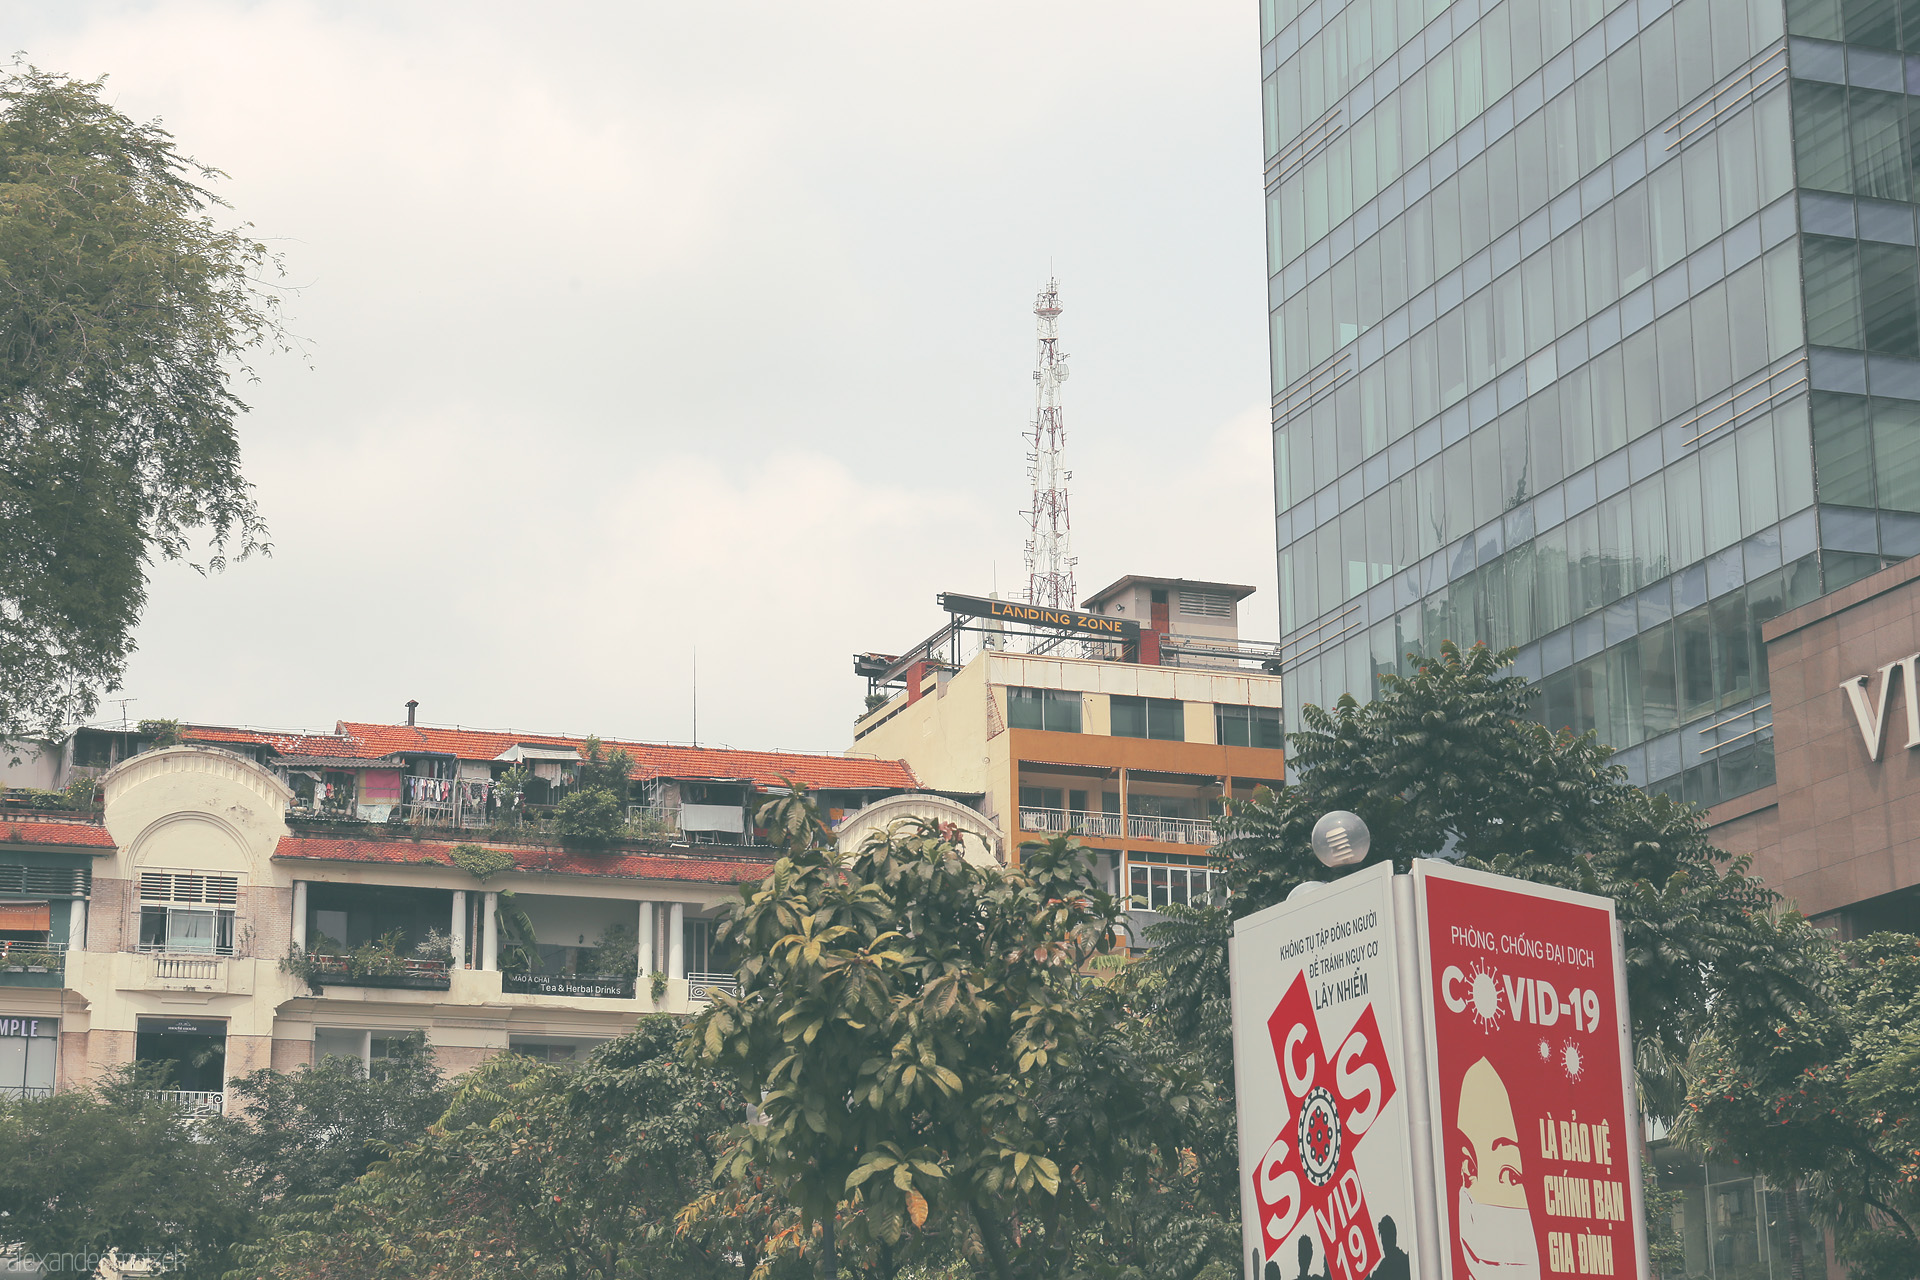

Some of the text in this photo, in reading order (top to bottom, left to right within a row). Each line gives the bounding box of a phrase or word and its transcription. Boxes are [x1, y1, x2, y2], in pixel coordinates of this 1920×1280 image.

[991, 602, 1122, 632] LANDING ZONE
[1839, 652, 1920, 762] VI
[1280, 909, 1377, 961] KHÔNG TỤ TẬP ĐÔNG NGƯỜI
[1451, 925, 1594, 970] PHÒNG, CHỐNG ĐẠI DỊCH
[1309, 940, 1378, 978] ĐỂ TRÁNH NGUY CƠ
[541, 984, 621, 995] Tea & Herbal Drinks
[1315, 967, 1369, 1010] LÂY NHIỄM
[0, 1019, 38, 1037] MPLE
[1539, 1109, 1612, 1175] LÀ BẢO VỆ
[1544, 1169, 1625, 1230] CHÍNH BẠN
[1548, 1226, 1614, 1276] GIA ĐÌNH
